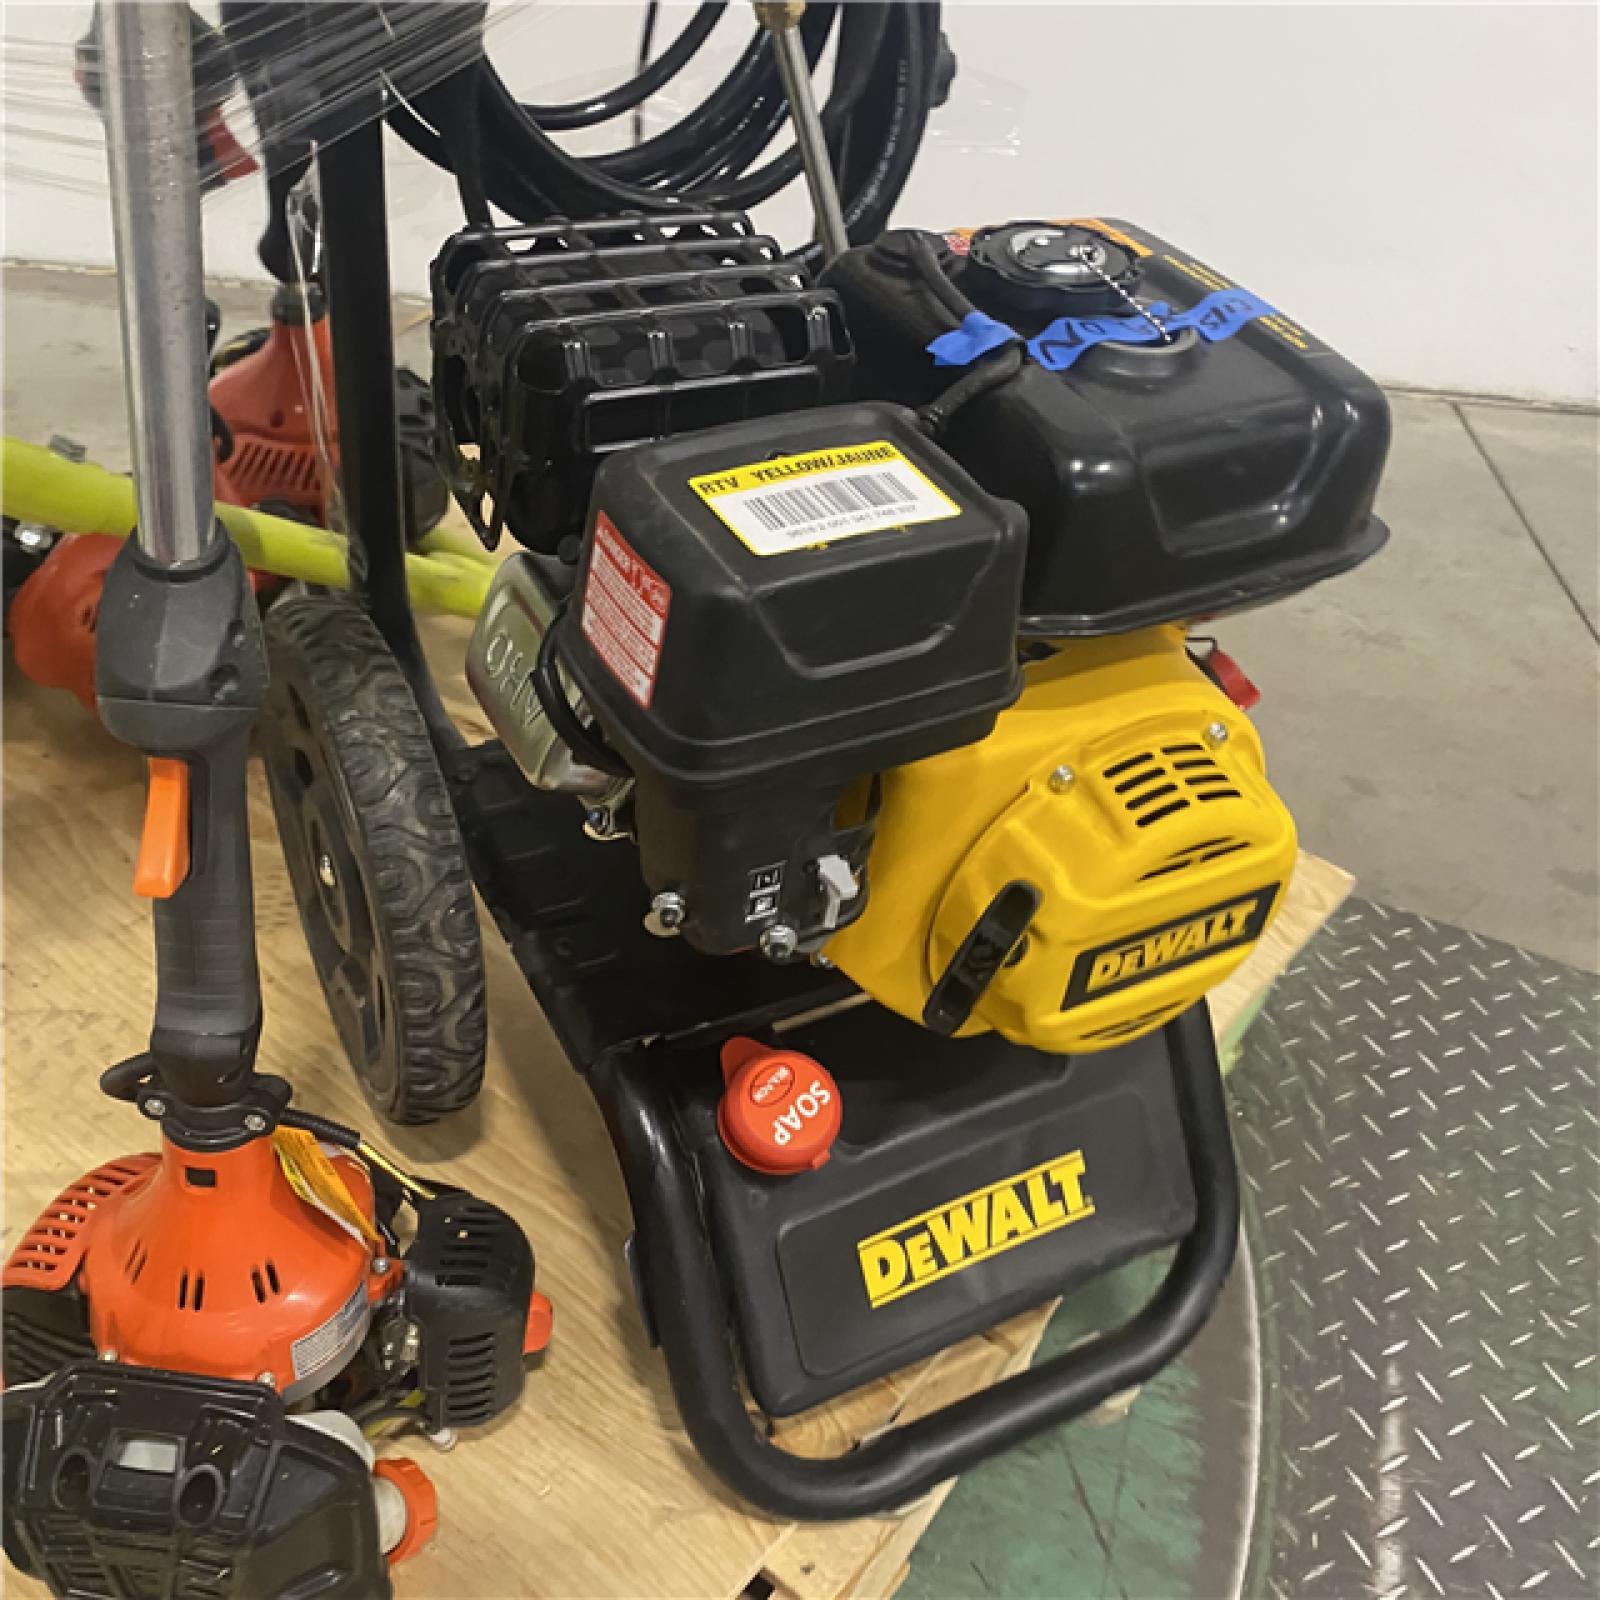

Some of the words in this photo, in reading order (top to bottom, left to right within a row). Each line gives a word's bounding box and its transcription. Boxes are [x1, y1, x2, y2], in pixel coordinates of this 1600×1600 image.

[698, 476, 740, 496] RTV
[1086, 899, 1258, 992] DEWALT
[773, 1080, 831, 1146] SOAP
[857, 1151, 1092, 1306] DEWALT
